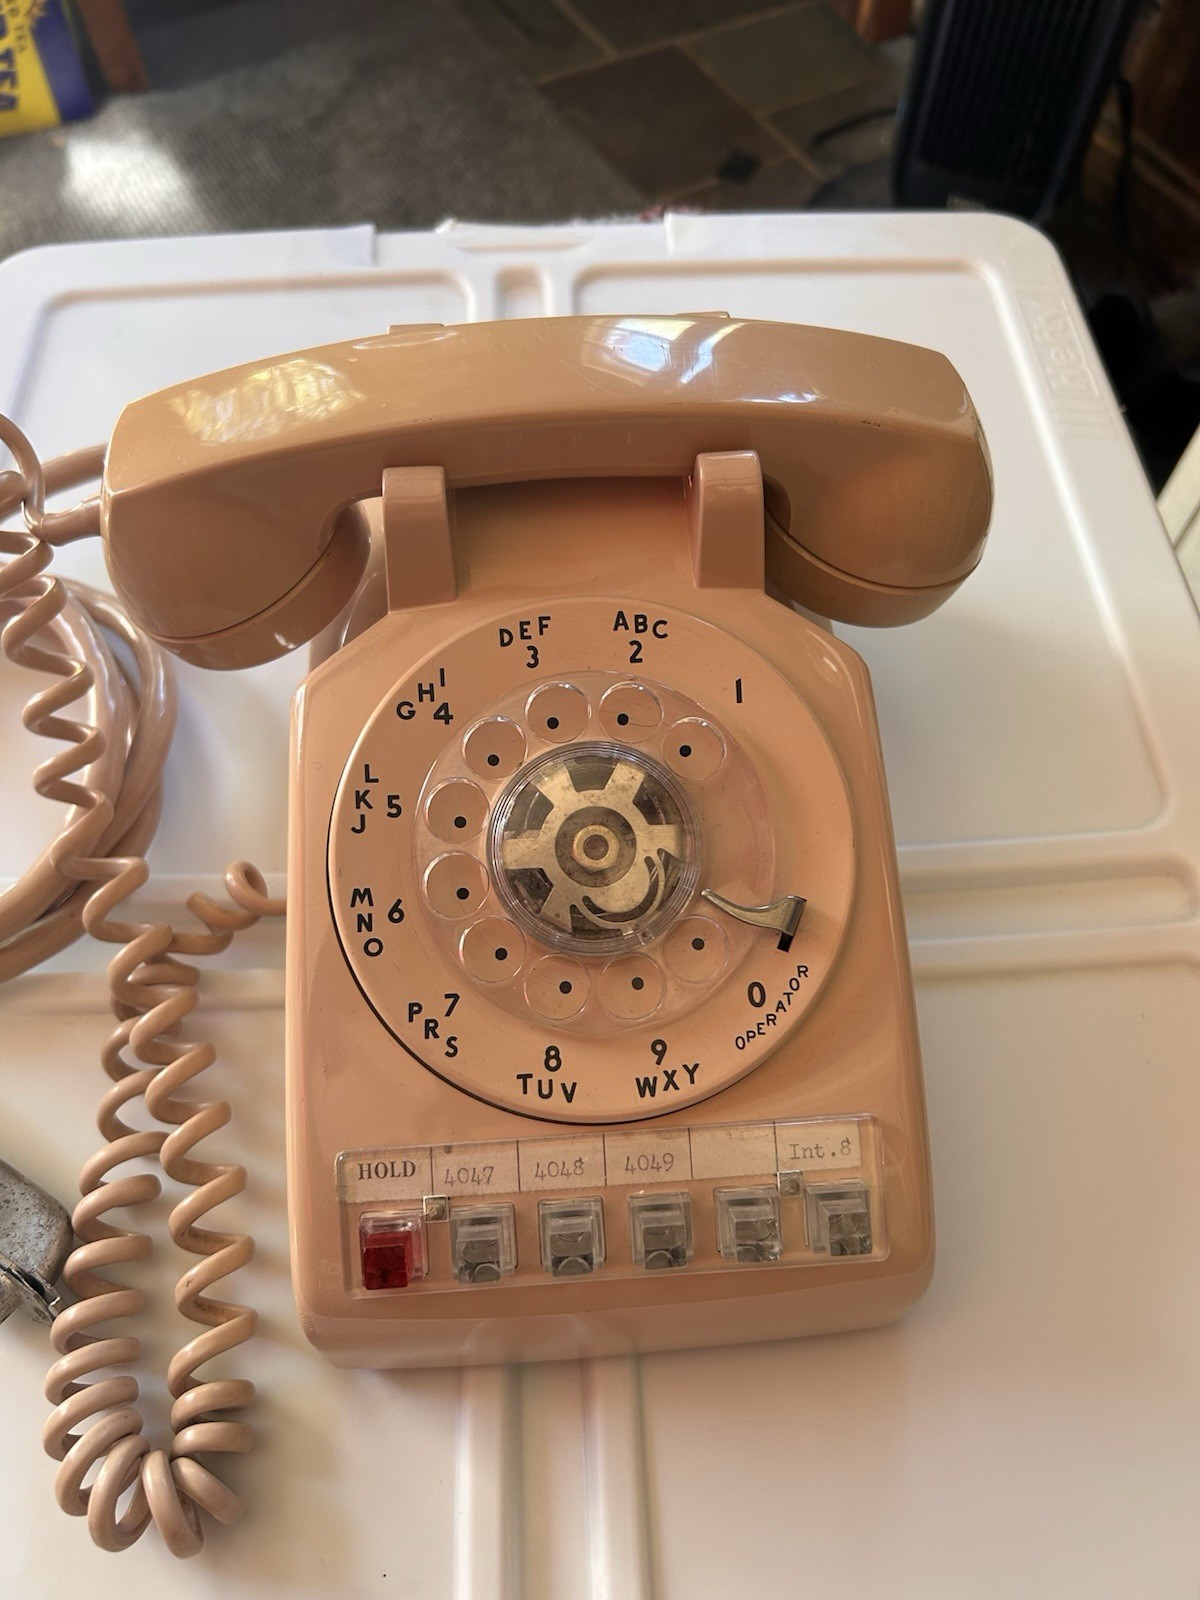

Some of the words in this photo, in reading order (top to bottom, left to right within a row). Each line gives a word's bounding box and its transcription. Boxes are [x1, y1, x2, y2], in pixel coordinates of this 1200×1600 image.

[499, 616, 551, 647] DEF
[613, 611, 668, 639] ABC
[526, 645, 539, 668] 3
[629, 640, 643, 663] 2
[735, 677, 743, 704] 1
[433, 702, 454, 725] 4
[386, 795, 402, 818] 5
[387, 898, 405, 924] 6
[444, 993, 460, 1017] 7
[735, 965, 809, 1050] OPERATOR
[747, 981, 766, 1008] 0
[544, 1045, 562, 1072] 8
[650, 1039, 667, 1065] 9
[516, 1073, 577, 1103] TUV
[635, 1063, 700, 1098] WXY
[357, 1160, 416, 1180] HOLD
[534, 1157, 585, 1180] 4048
[624, 1152, 675, 1174] 4049
[444, 1166, 495, 1187] 4047
